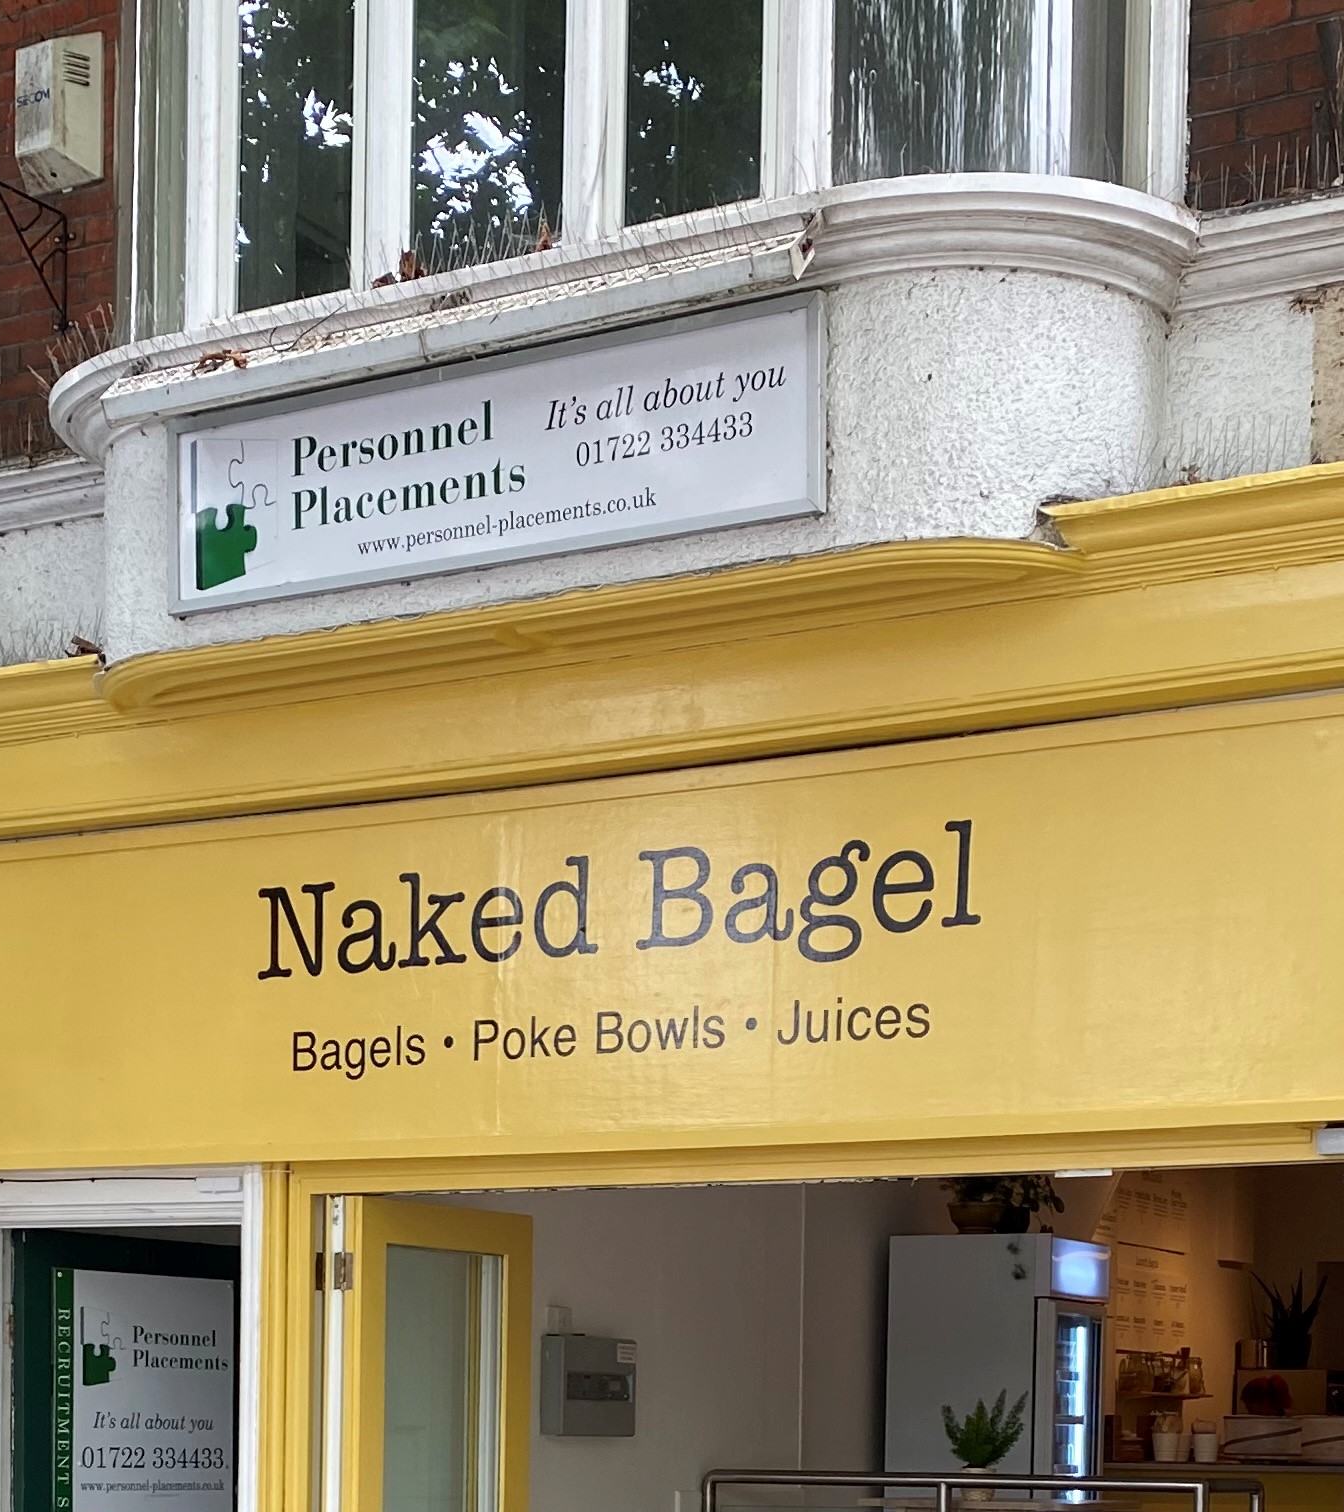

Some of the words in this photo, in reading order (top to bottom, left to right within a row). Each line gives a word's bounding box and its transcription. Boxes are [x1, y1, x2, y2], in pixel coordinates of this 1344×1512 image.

[545, 396, 587, 431] It's
[596, 386, 634, 421] all
[644, 374, 725, 413] about
[734, 365, 786, 403] you
[291, 400, 494, 477] Personnel
[576, 434, 651, 468] 01722
[660, 412, 753, 453] 334433
[291, 457, 526, 530] Placements
[358, 486, 656, 556] www.personnel-placements.co.uk
[258, 854, 598, 979] Naked
[636, 820, 982, 963] Bagel
[293, 1024, 425, 1080] Bagels
[473, 1016, 576, 1062] Poke
[596, 1004, 725, 1054] Bowls
[778, 996, 930, 1047] Juices
[133, 1325, 216, 1348] Personnel
[133, 1349, 229, 1371] Placements
[57, 1308, 70, 1484] RECRUITMENT
[93, 1412, 115, 1429] It's
[121, 1413, 140, 1430] all
[145, 1412, 185, 1431] about
[188, 1417, 214, 1435] you
[82, 1446, 145, 1469] 01722
[153, 1447, 224, 1469] 334433
